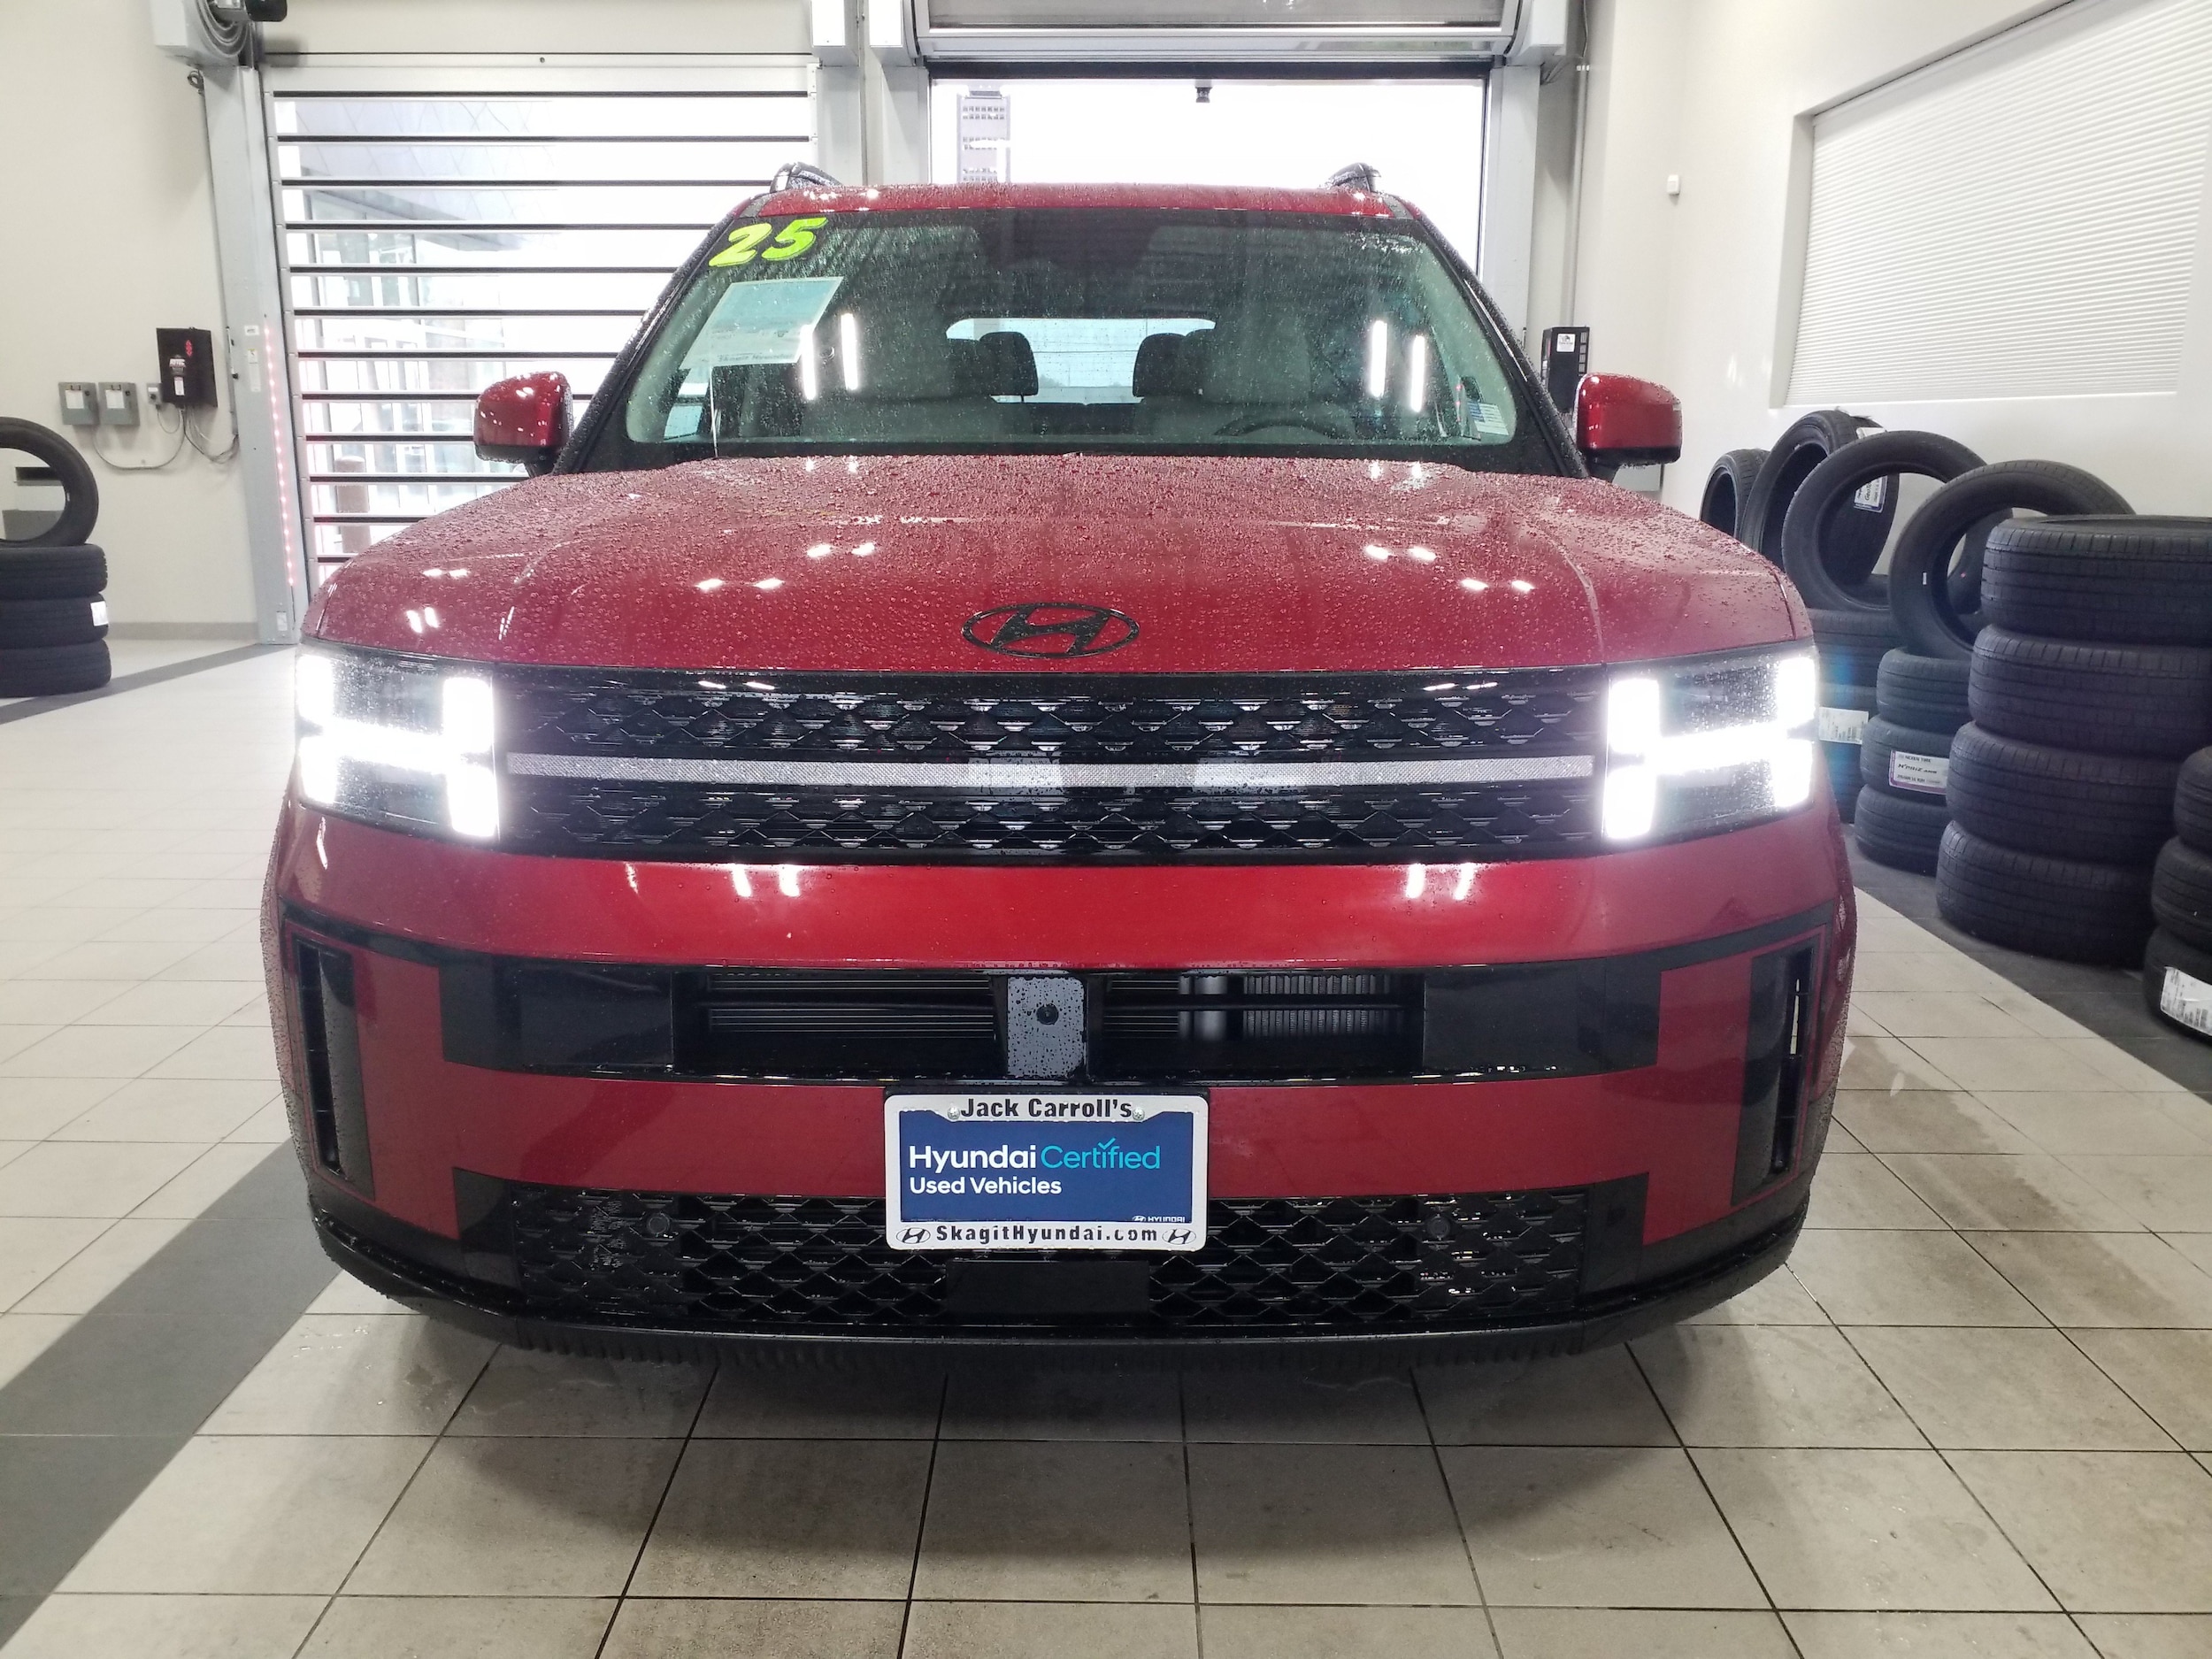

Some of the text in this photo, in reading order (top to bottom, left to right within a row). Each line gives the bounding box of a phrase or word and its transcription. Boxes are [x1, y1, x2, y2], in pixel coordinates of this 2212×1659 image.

[709, 217, 828, 267] 25
[961, 1098, 1133, 1118] Jack Carroll's
[909, 1138, 1161, 1174] Hyundai Certified
[910, 1177, 1062, 1194] Used Vehicles
[935, 1225, 1157, 1244] SkagitHyundai.com
